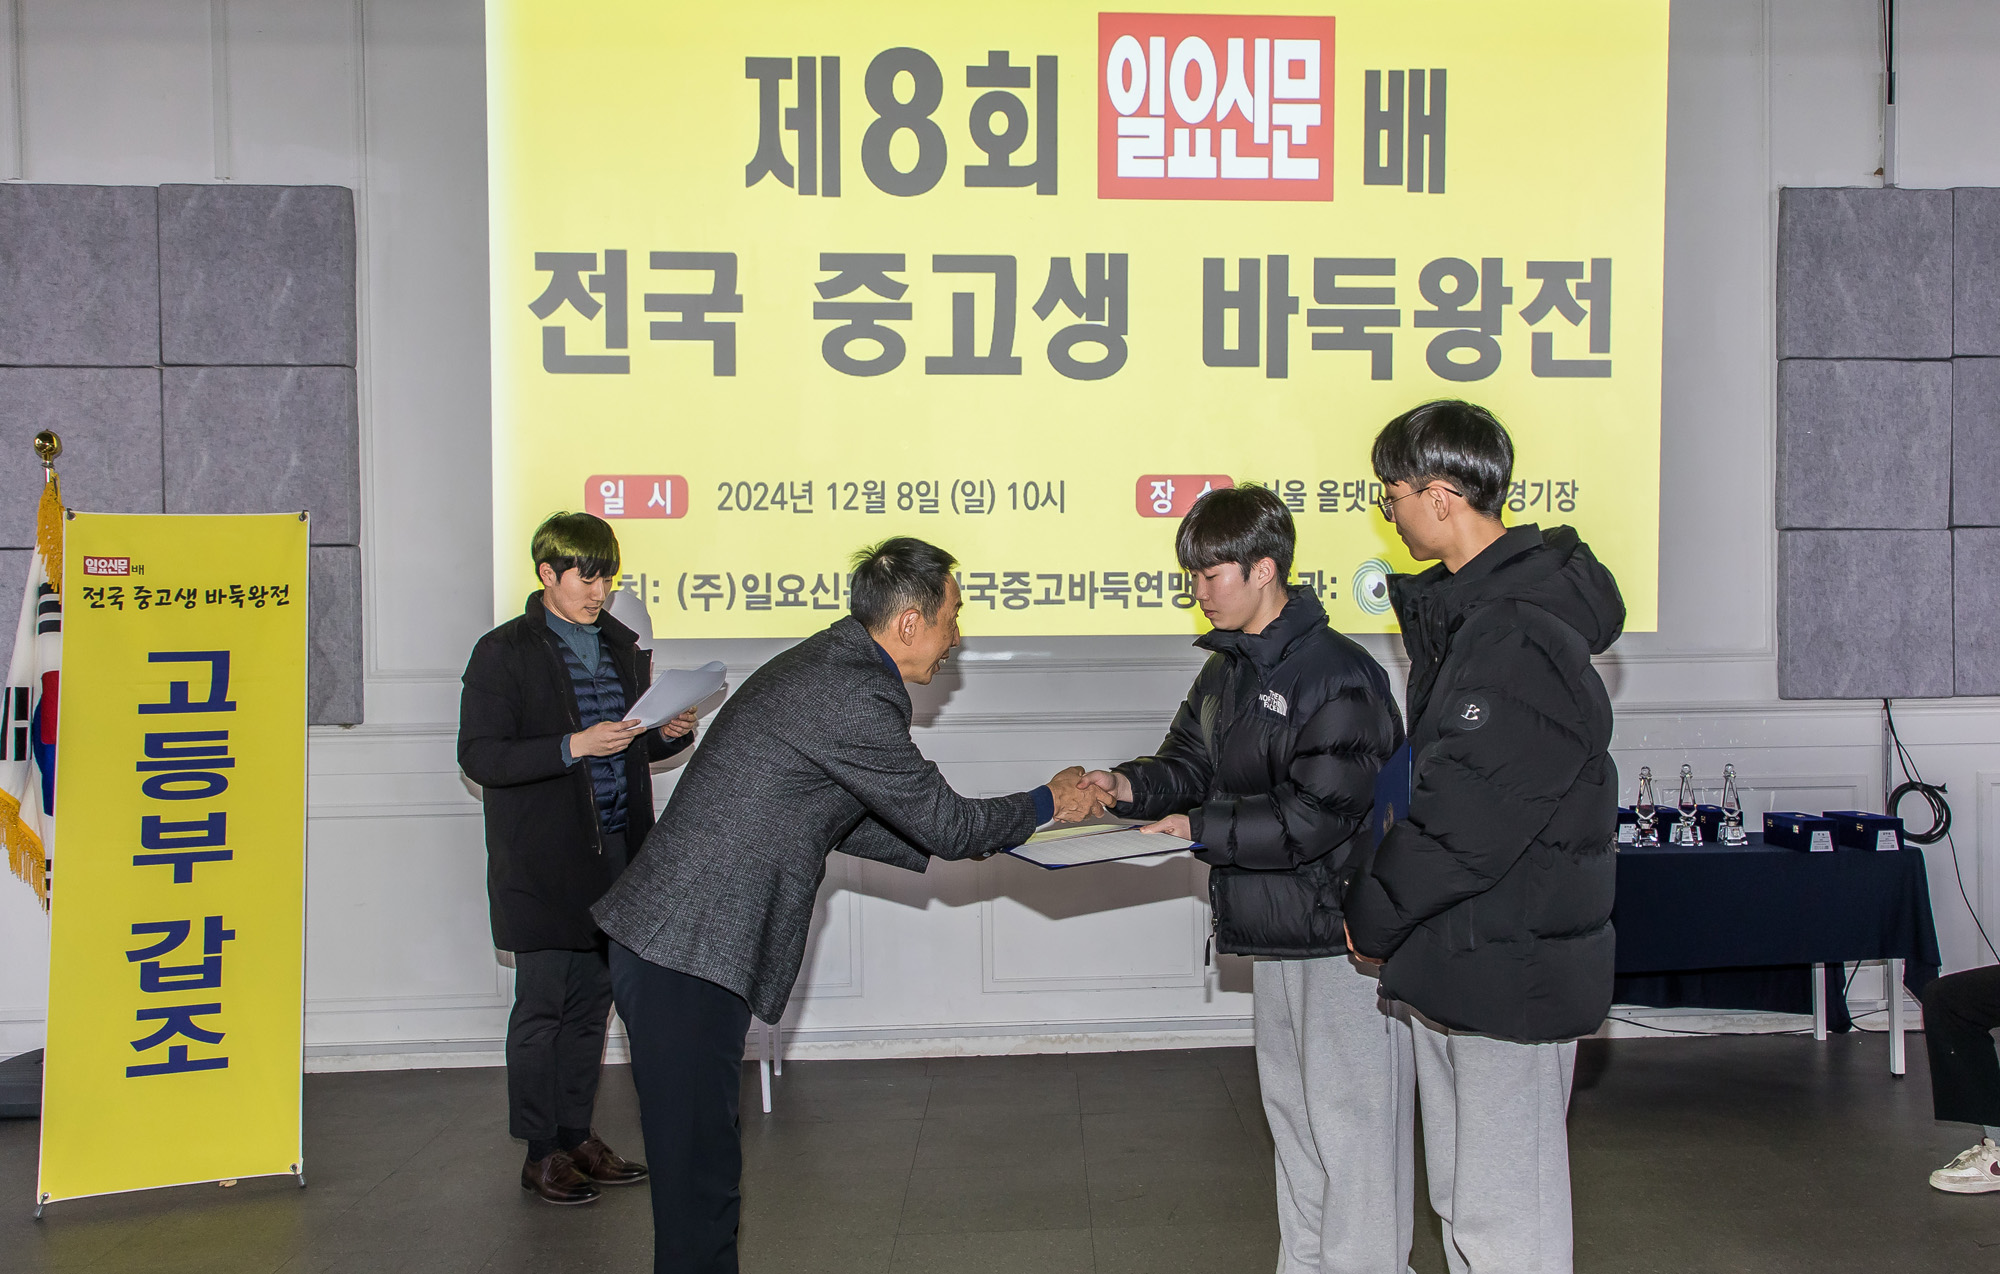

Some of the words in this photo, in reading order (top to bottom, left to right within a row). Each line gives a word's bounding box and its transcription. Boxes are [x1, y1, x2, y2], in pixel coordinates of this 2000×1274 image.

[744, 46, 1059, 198] 제8회
[1106, 34, 1321, 181] 일요신문
[1363, 68, 1448, 195] 배
[528, 248, 744, 377] 전국
[812, 252, 1129, 381] 중고생
[1202, 254, 1613, 383] 바둑왕전
[717, 480, 814, 514] 2024년
[827, 480, 887, 514] 12월
[897, 480, 940, 514] 8일
[950, 479, 996, 516] (일)
[1007, 479, 1066, 514] 10시
[83, 586, 125, 611] 전국
[133, 585, 198, 610] 중고생
[205, 584, 290, 609] 바둑왕전
[85, 558, 128, 574] 일요신문
[131, 564, 145, 576] 배
[677, 571, 852, 612] (주)일요신
[132, 650, 237, 884] 고등부
[124, 915, 236, 1079] 갑조
